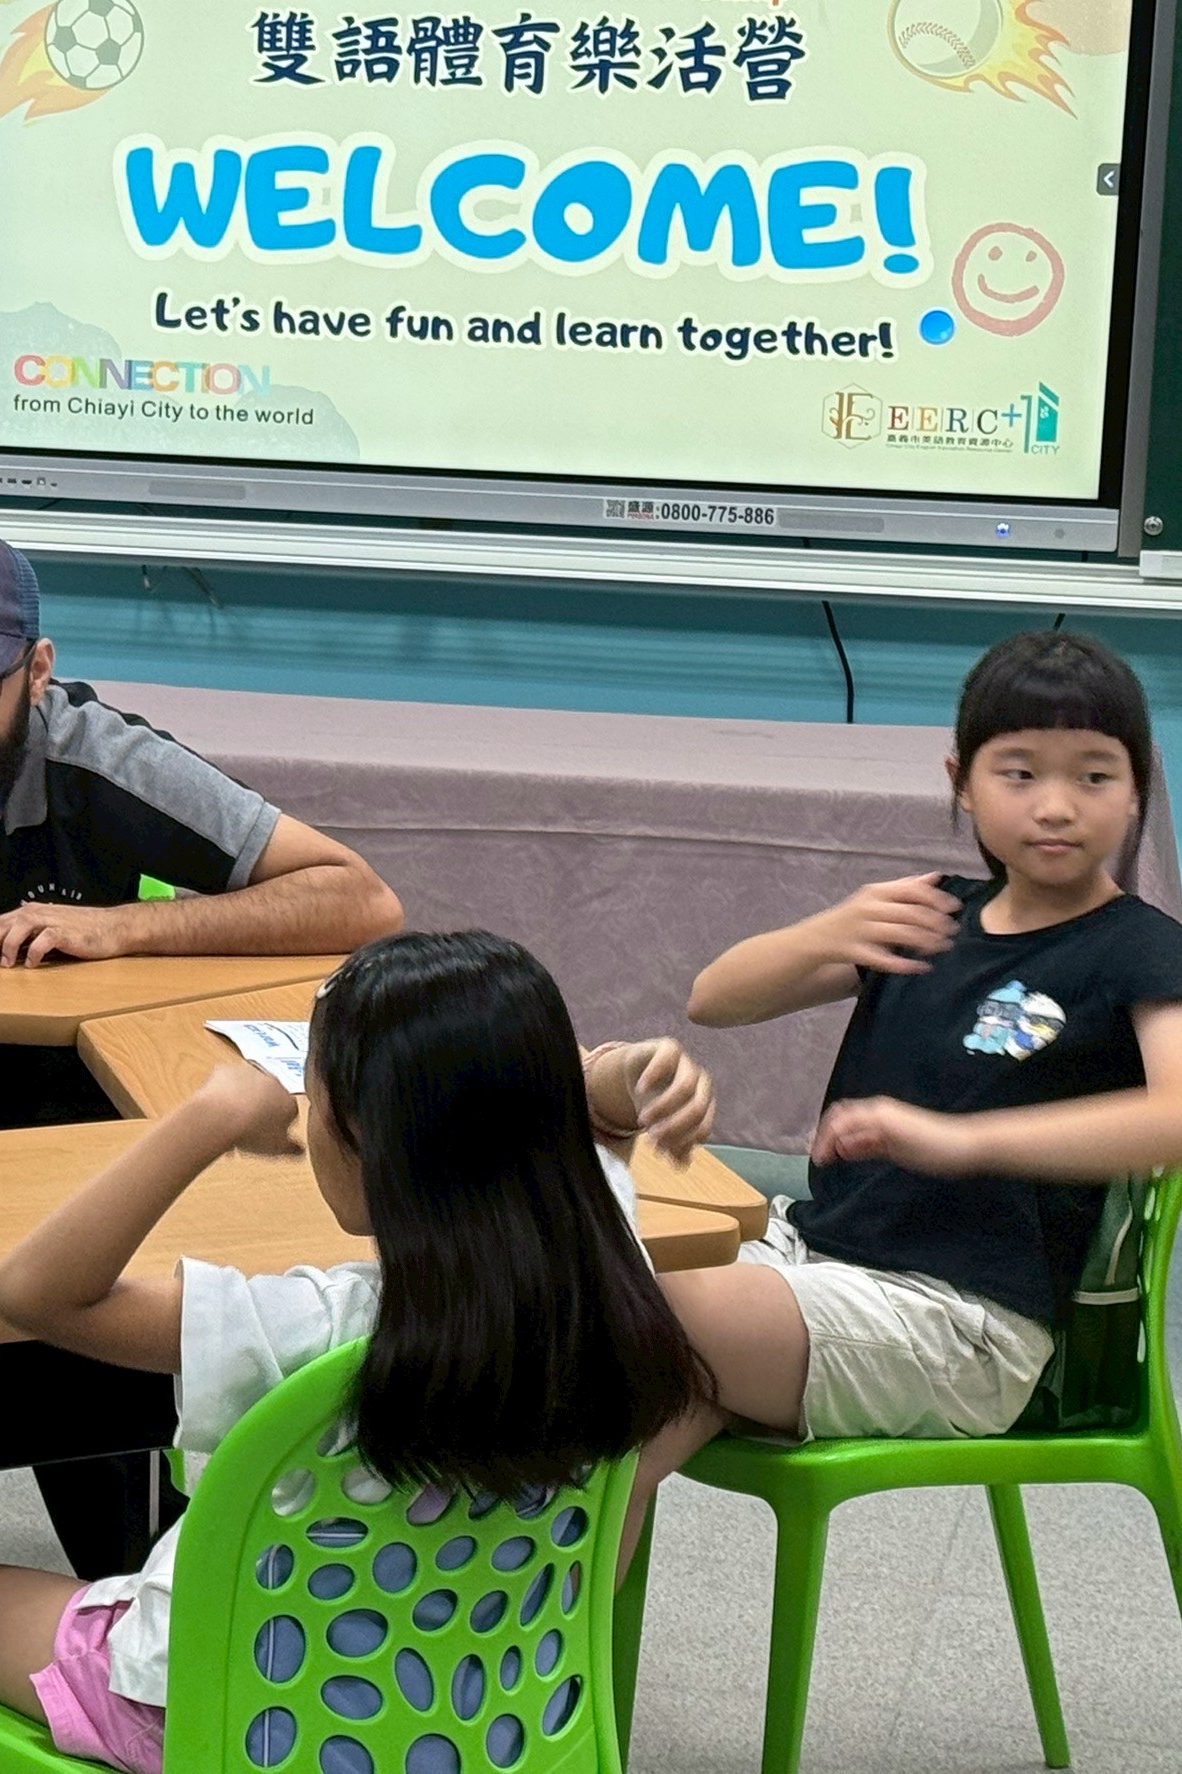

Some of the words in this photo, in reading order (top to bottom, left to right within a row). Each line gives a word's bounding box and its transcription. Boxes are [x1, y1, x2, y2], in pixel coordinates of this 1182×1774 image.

[251, 13, 805, 101] 雙語體育樂活營
[126, 145, 919, 273] WELCOME!
[155, 292, 260, 332] Let's
[274, 301, 371, 336] have
[386, 306, 454, 341] fun
[467, 312, 541, 345] and
[557, 312, 663, 350] learn
[677, 317, 895, 360] together!
[13, 354, 271, 397] CONNECTION
[14, 394, 61, 413] from
[68, 397, 135, 420] Chiayi
[141, 400, 183, 423] City
[190, 403, 210, 421] to
[215, 405, 248, 422] the
[255, 408, 314, 426] world
[1031, 445, 1060, 455] CITY
